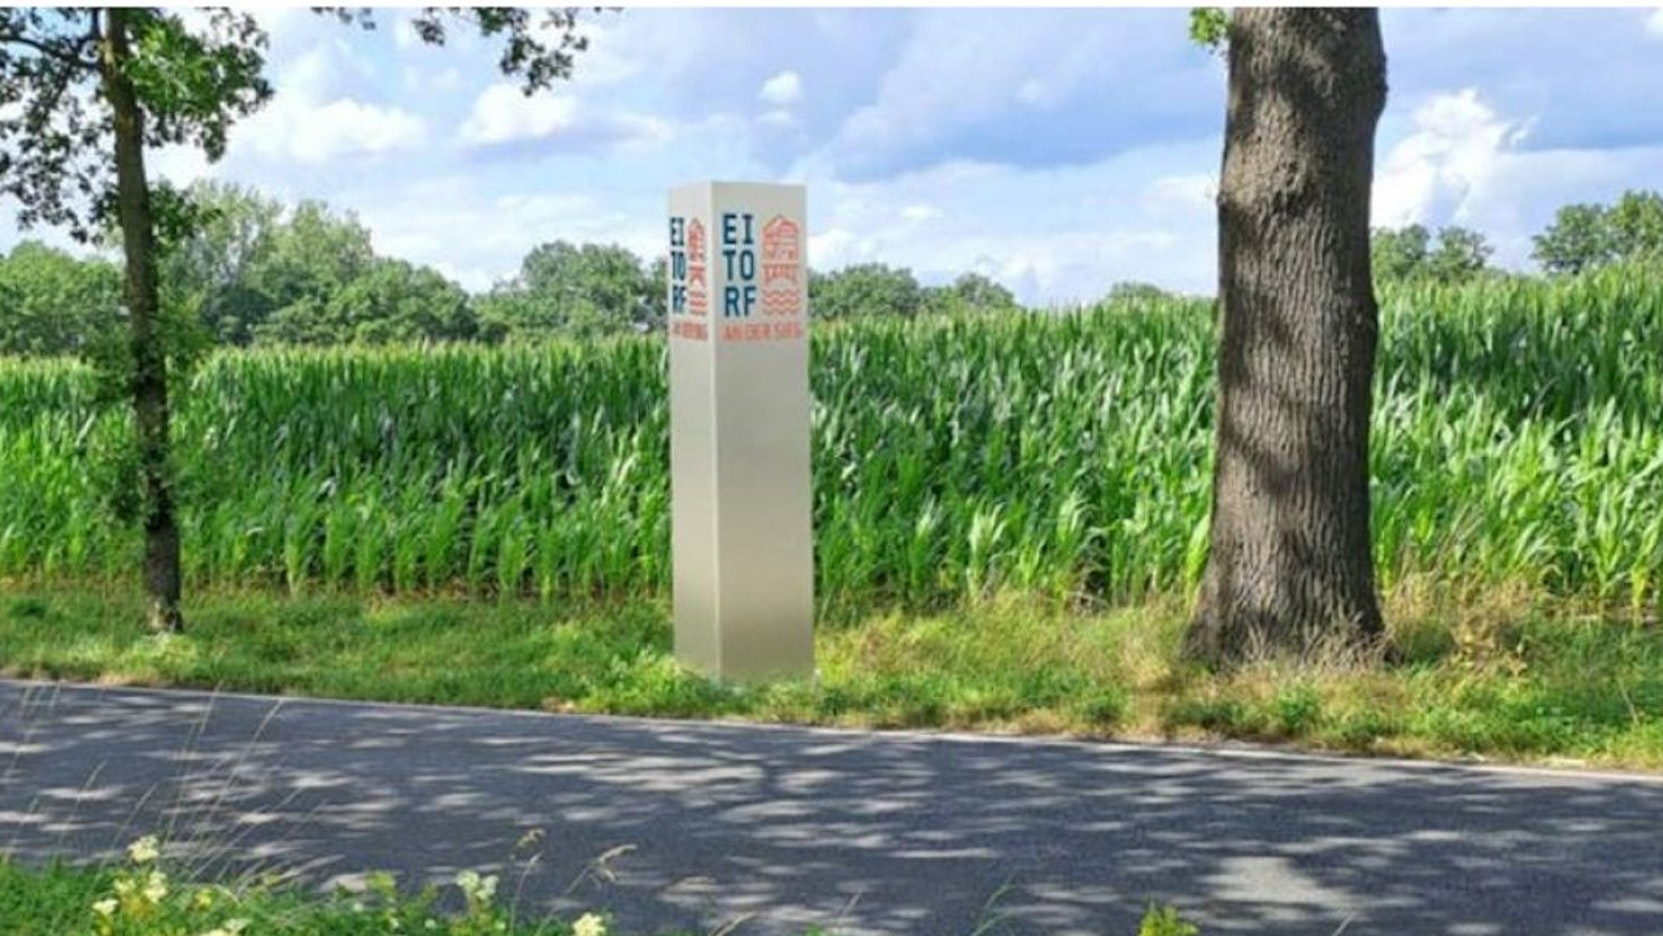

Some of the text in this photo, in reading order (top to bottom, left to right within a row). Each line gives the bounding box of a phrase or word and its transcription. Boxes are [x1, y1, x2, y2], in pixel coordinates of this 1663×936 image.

[670, 217, 684, 246] EI
[723, 213, 754, 244] EI
[670, 251, 686, 281] TO
[722, 249, 754, 280] TO
[724, 286, 757, 317] RF
